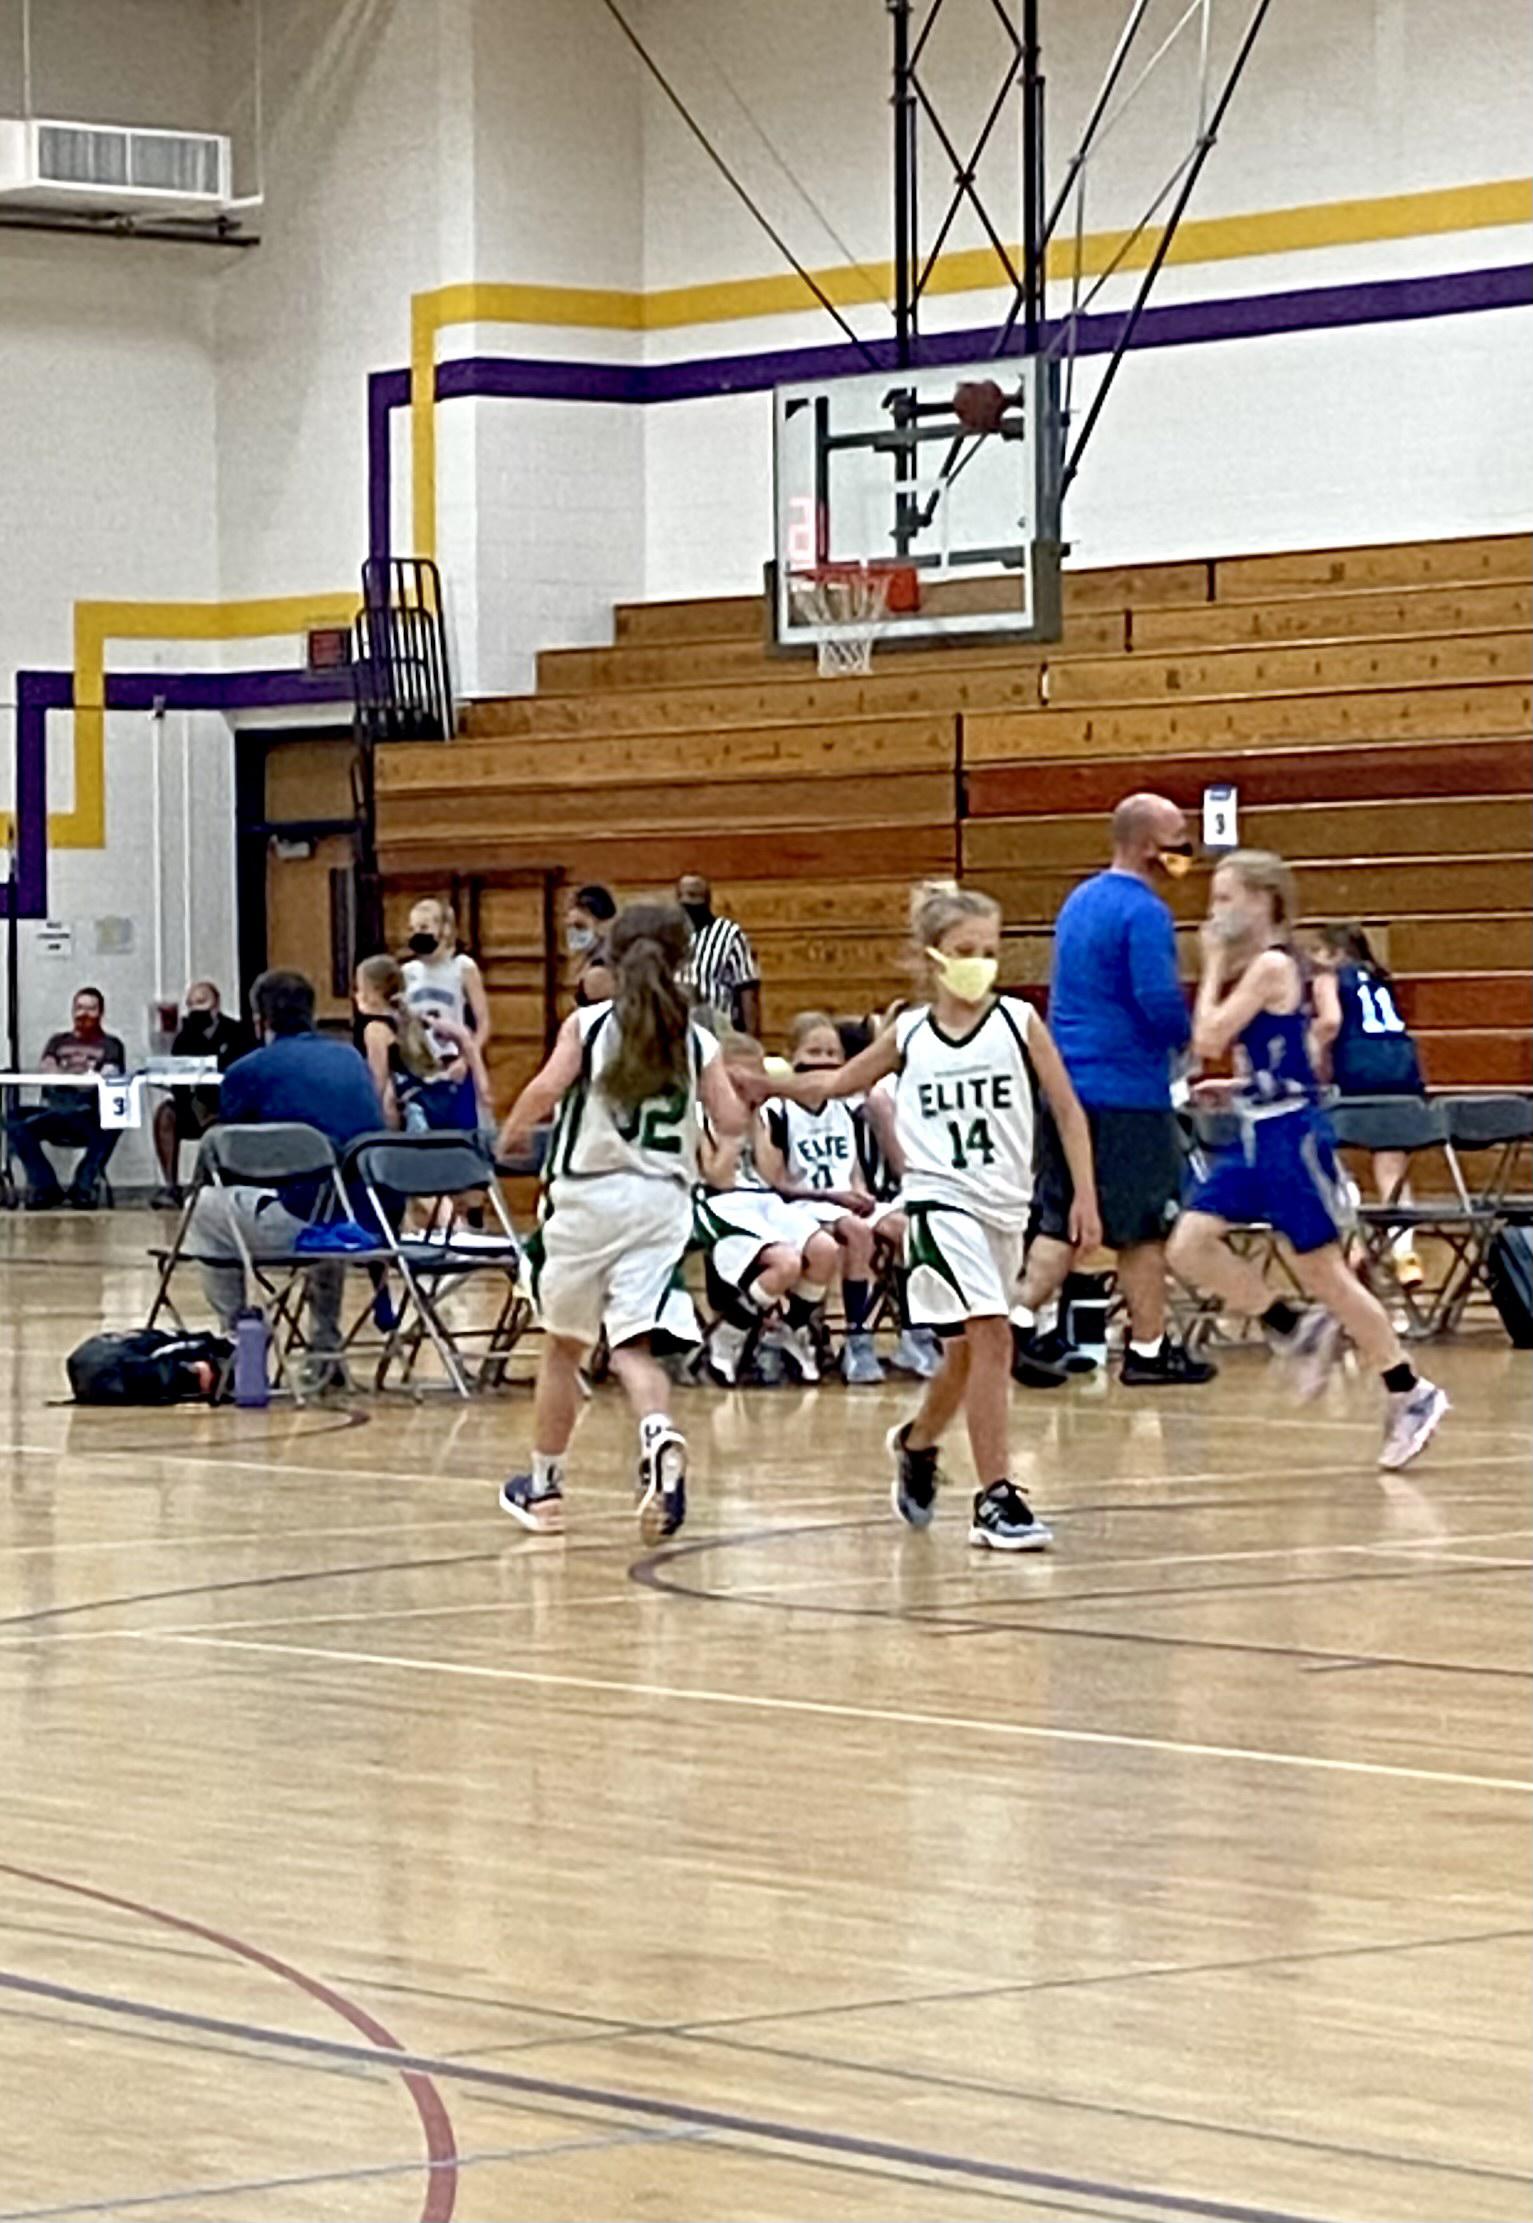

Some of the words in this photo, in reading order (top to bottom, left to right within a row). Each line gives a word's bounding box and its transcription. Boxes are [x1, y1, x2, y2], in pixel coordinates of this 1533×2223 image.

[1356, 984, 1406, 1034] 11
[112, 1095, 126, 1117] 3
[917, 1074, 1013, 1120] ELITE
[946, 1118, 996, 1170] 14
